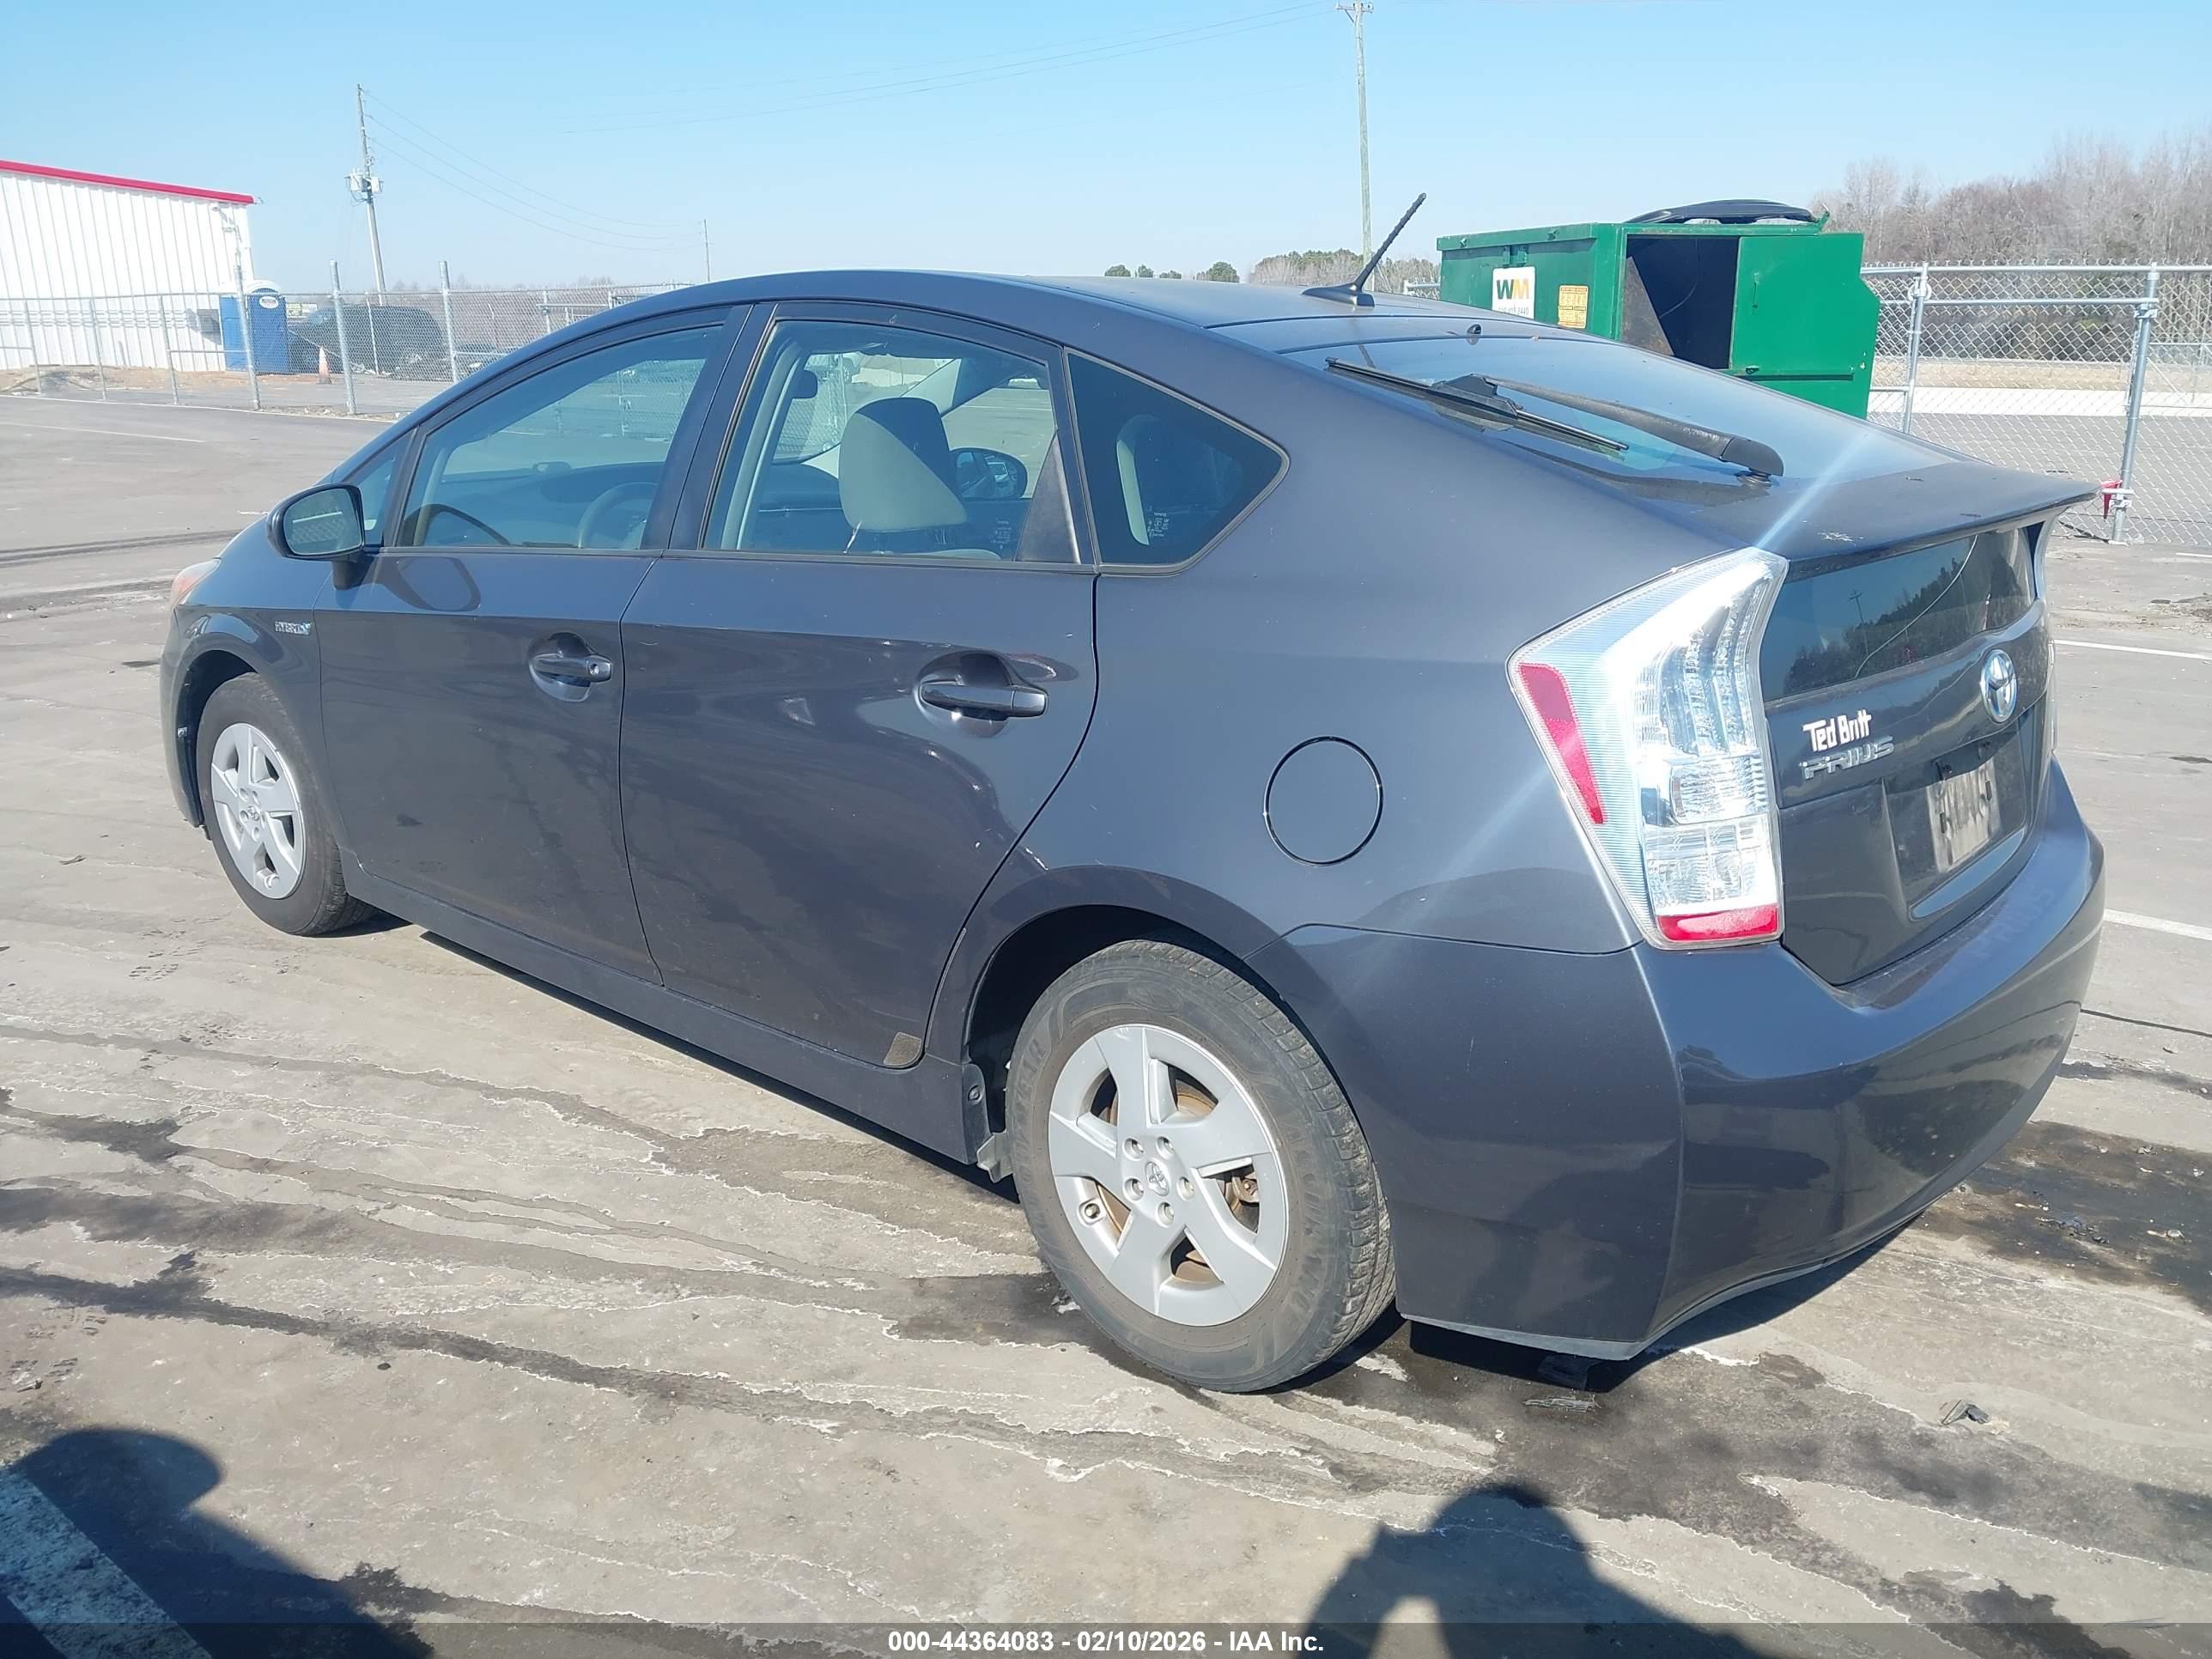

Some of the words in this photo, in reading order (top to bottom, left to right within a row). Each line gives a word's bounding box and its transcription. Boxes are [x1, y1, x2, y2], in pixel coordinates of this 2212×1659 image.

[1496, 278, 1530, 300] WM
[1802, 718, 1838, 752] Ted
[1837, 708, 1872, 744] Britt
[1798, 736, 1895, 780] PRIUS
